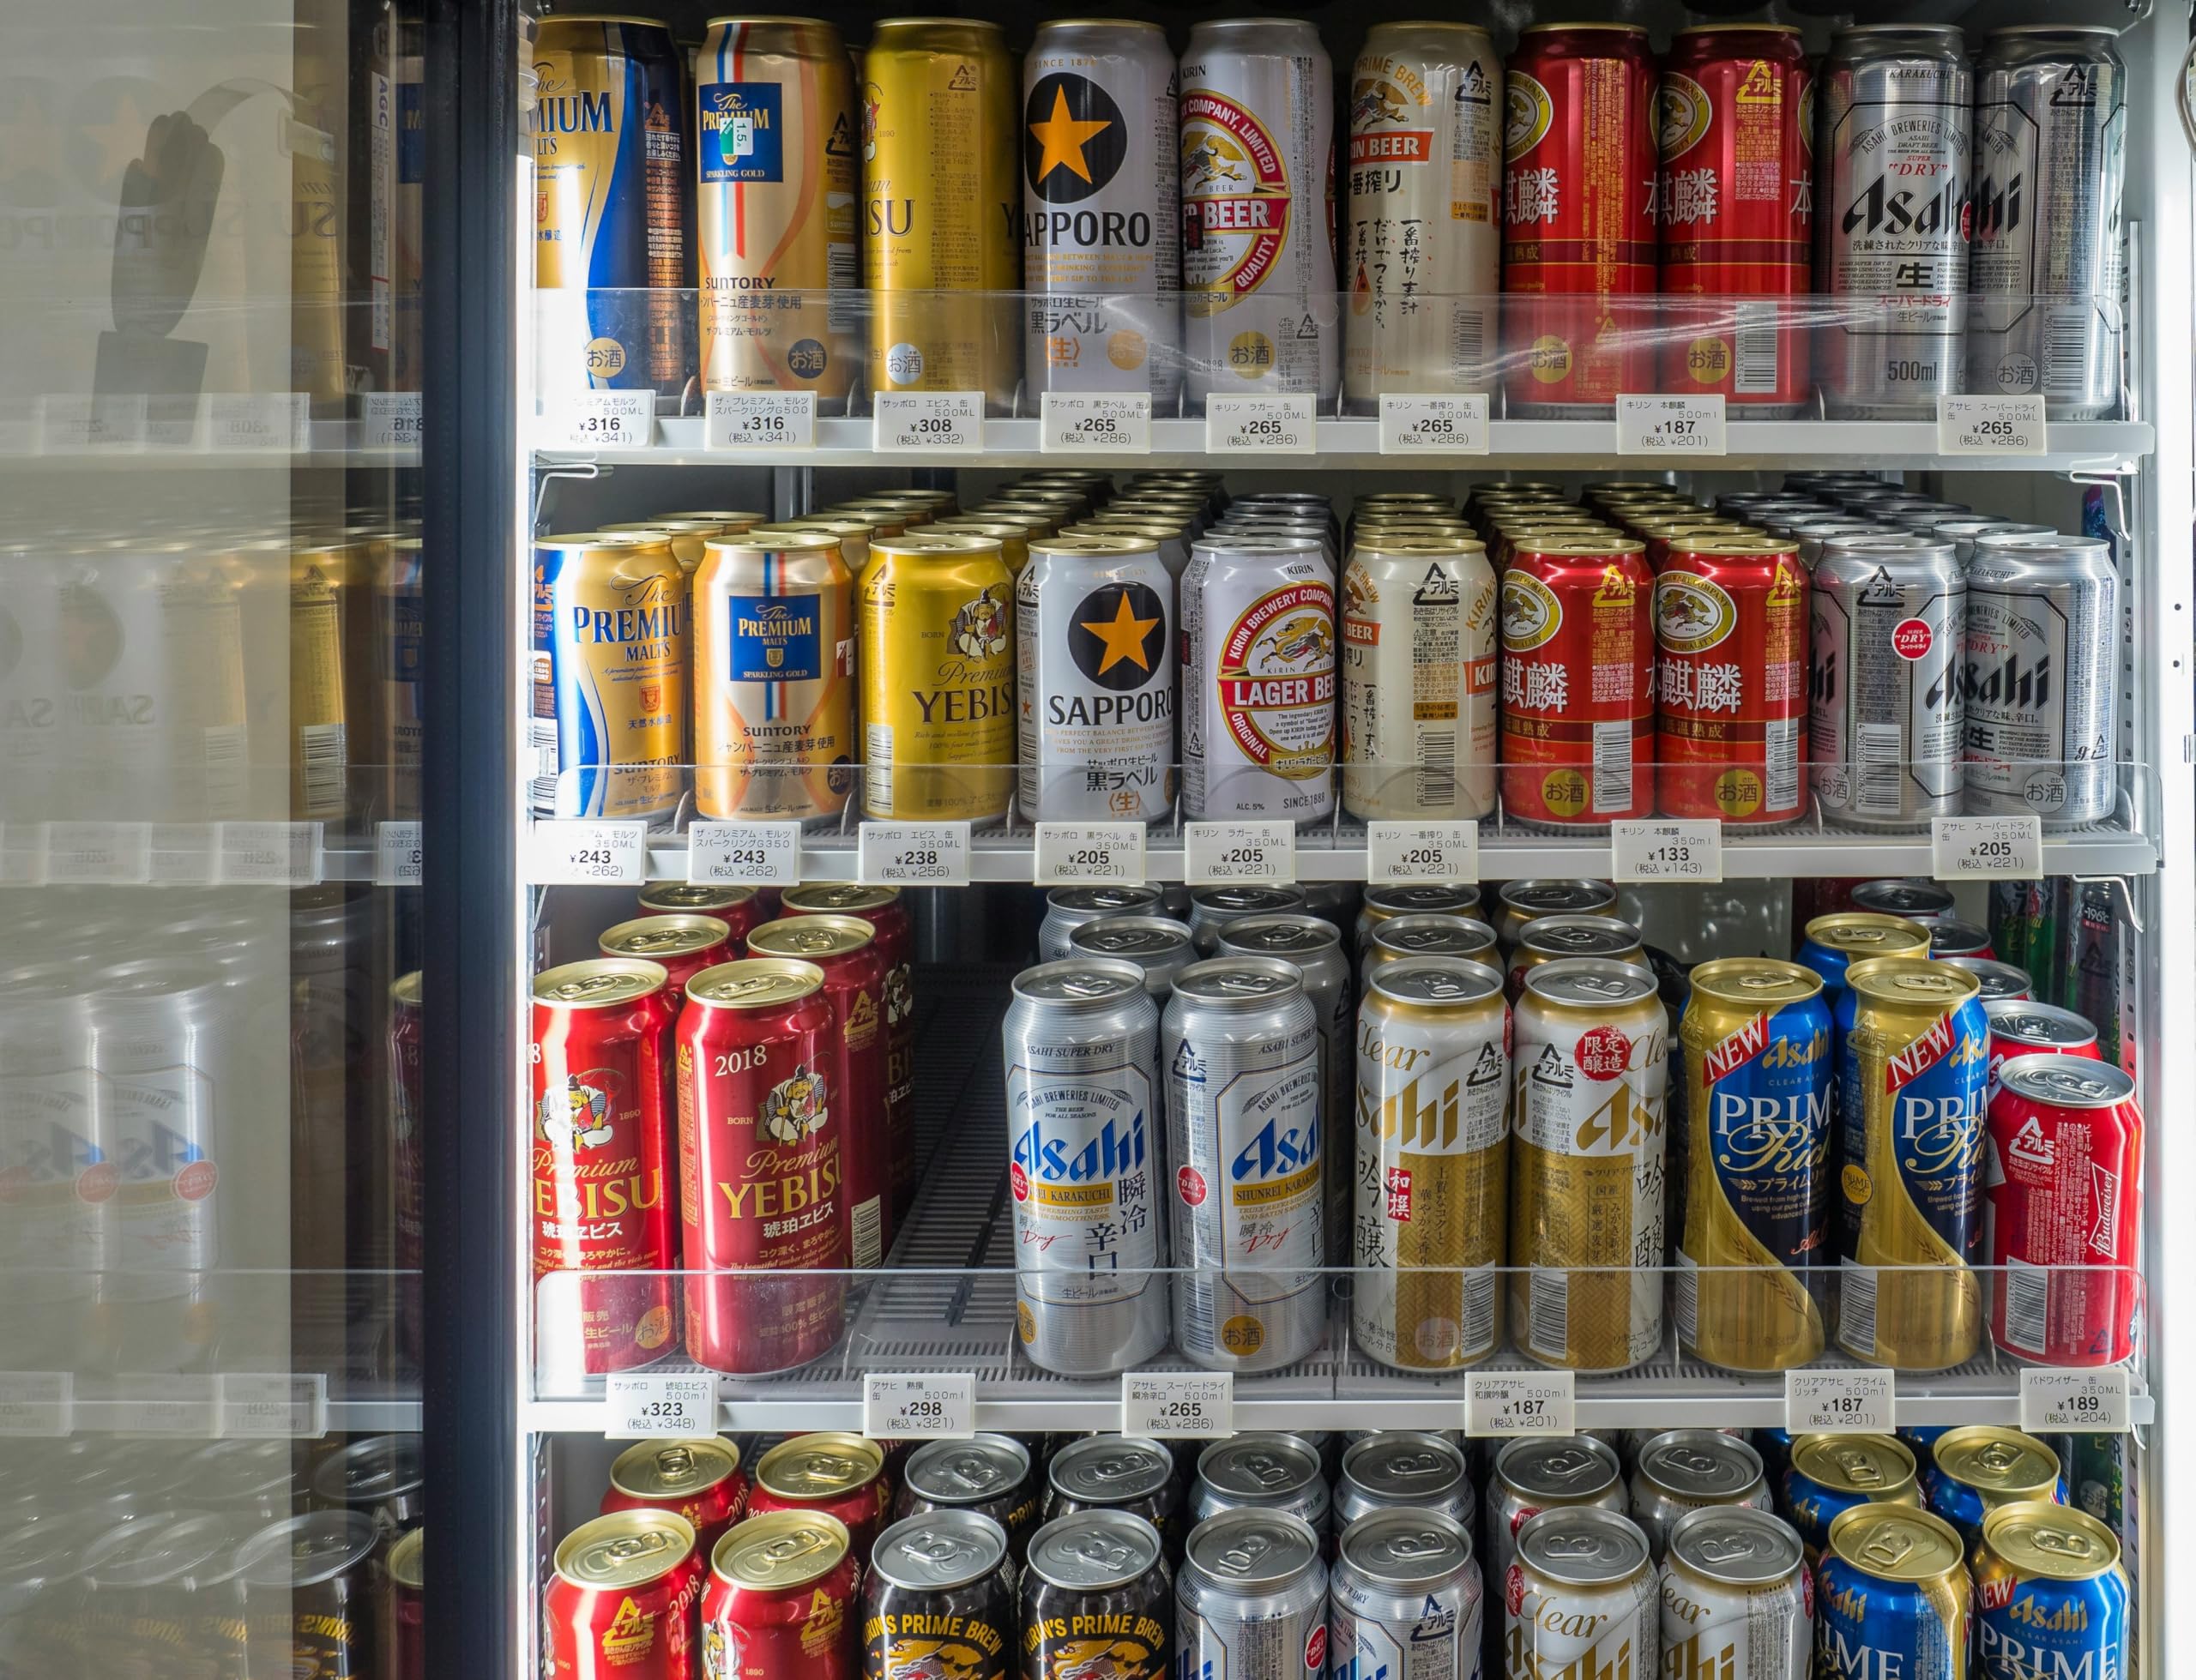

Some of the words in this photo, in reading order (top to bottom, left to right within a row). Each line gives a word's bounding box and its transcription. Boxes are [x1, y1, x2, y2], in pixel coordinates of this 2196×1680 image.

[1182, 65, 1206, 77] KIRIN
[1358, 57, 1393, 74] PRIME
[1394, 64, 1434, 107] BREW
[1243, 123, 1276, 174] LIMITED
[1369, 137, 1420, 156] BEER
[740, 170, 765, 178] GOLD
[1204, 201, 1270, 229] BEER
[1025, 212, 1151, 247] APPORO
[1235, 237, 1275, 287] QUALITY
[1897, 262, 1934, 288] 生
[705, 277, 775, 289] SUNTORY
[1031, 313, 1107, 334] 黒ラベル
[587, 350, 621, 368] お酒
[791, 351, 823, 369] お酒
[1232, 346, 1270, 364] お酒
[1888, 361, 1936, 381] 500ml
[1998, 365, 2034, 385] お酒
[1050, 400, 1084, 408] サッポロ
[1093, 400, 1126, 409] 黒ラベル
[1215, 403, 1240, 412] キリン
[1249, 403, 1275, 412] ラガー
[1386, 401, 1412, 410] キリン
[1421, 401, 1453, 410] 一番搾り
[1660, 400, 1685, 410] 本麒麟
[1947, 402, 1971, 411] アサヒ
[1103, 410, 1142, 418] 500ML
[1439, 411, 1478, 419] 500ML
[1999, 412, 2037, 421] 500ML
[579, 418, 619, 431] ¥316
[742, 418, 784, 430] ¥316
[910, 419, 952, 432] ¥308
[1075, 418, 1115, 431] ¥265
[1240, 421, 1281, 434] ¥265
[1412, 419, 1452, 432] ¥265
[1655, 421, 1695, 434] ¥187
[1972, 421, 2012, 434] ¥265
[1288, 564, 1314, 575] KIRIN
[1431, 581, 1458, 596] アルミ
[574, 605, 685, 643] PREMIU
[739, 618, 811, 637] PREMIUM
[1229, 629, 1248, 659] KIRIN
[1247, 591, 1297, 629] BREWERY
[1347, 625, 1372, 640] BEER
[1234, 681, 1308, 706] LAGER
[913, 686, 1014, 723] YEBIS
[743, 725, 811, 736] SUNTORY
[1232, 714, 1268, 758] ORIGINAL
[1087, 767, 1157, 791] 黒ラベル
[1284, 797, 1309, 809] SINCE
[1311, 792, 1324, 805] 1888
[1654, 827, 1679, 836] 本麒麟
[1942, 822, 1965, 831] アサヒ
[1975, 822, 2032, 831] スーパードライ
[867, 831, 901, 840] サッポロ
[1044, 831, 1077, 840] サッポロ
[1088, 832, 1120, 840] 黒ラベル
[1193, 829, 1218, 838] キリン
[1228, 829, 1252, 838] ラガー
[1376, 831, 1400, 840] キリン
[1410, 830, 1443, 839] 一番搾り
[595, 840, 635, 848] 350ML
[1970, 842, 2011, 856] ¥205
[570, 851, 611, 864] ¥243
[724, 851, 765, 864] ¥243
[896, 852, 937, 864] ¥238
[1069, 851, 1109, 864] ¥205
[1222, 850, 1263, 862] ¥205
[1401, 851, 1442, 863] ¥205
[1649, 848, 1689, 860] ¥133
[1028, 1046, 1053, 1057] ASAHI
[1056, 1047, 1091, 1057] SUPER
[1095, 1044, 1113, 1055] DRY
[1584, 1035, 1623, 1054] 限定
[1704, 1013, 1764, 1082] NEW
[1763, 1026, 1828, 1069] Asahi
[1887, 1015, 1952, 1087] NEW
[715, 1045, 767, 1077] 2018
[1045, 1090, 1088, 1103] BREWERIES
[1090, 1093, 1120, 1111] LIMITED
[1014, 1108, 1144, 1182] Asahi
[535, 1167, 662, 1219] EBISU
[1052, 1187, 1110, 1201] KARAKUCHI
[1236, 1185, 1281, 1201] SHUNREI
[2094, 1171, 2115, 1255] Budweiser
[1225, 1328, 1261, 1346] お酒
[614, 1382, 648, 1390] サッポロ
[873, 1382, 897, 1390] アサヒ
[1132, 1382, 1157, 1390] アサヒ
[1167, 1382, 1225, 1390] スーパードライ
[1475, 1380, 1525, 1388] クリアアサヒ
[1795, 1377, 1843, 1386] クリアアサヒ
[642, 1402, 683, 1416] ¥323
[900, 1402, 942, 1416] ¥298
[1160, 1403, 1201, 1416] ¥265
[1503, 1401, 1544, 1414] ¥187
[1822, 1399, 1862, 1412] ¥187
[2058, 1397, 2098, 1410] ¥189
[669, 1575, 700, 1619] 2018
[1976, 1578, 2012, 1611] NEW
[1520, 1591, 1607, 1638] Clear
[2010, 1594, 2088, 1632] Asahi
[902, 1615, 962, 1634] PRIME
[968, 1621, 1002, 1657] BREW
[1073, 1615, 1125, 1635] PRIME
[1135, 1617, 1166, 1651] BREW
